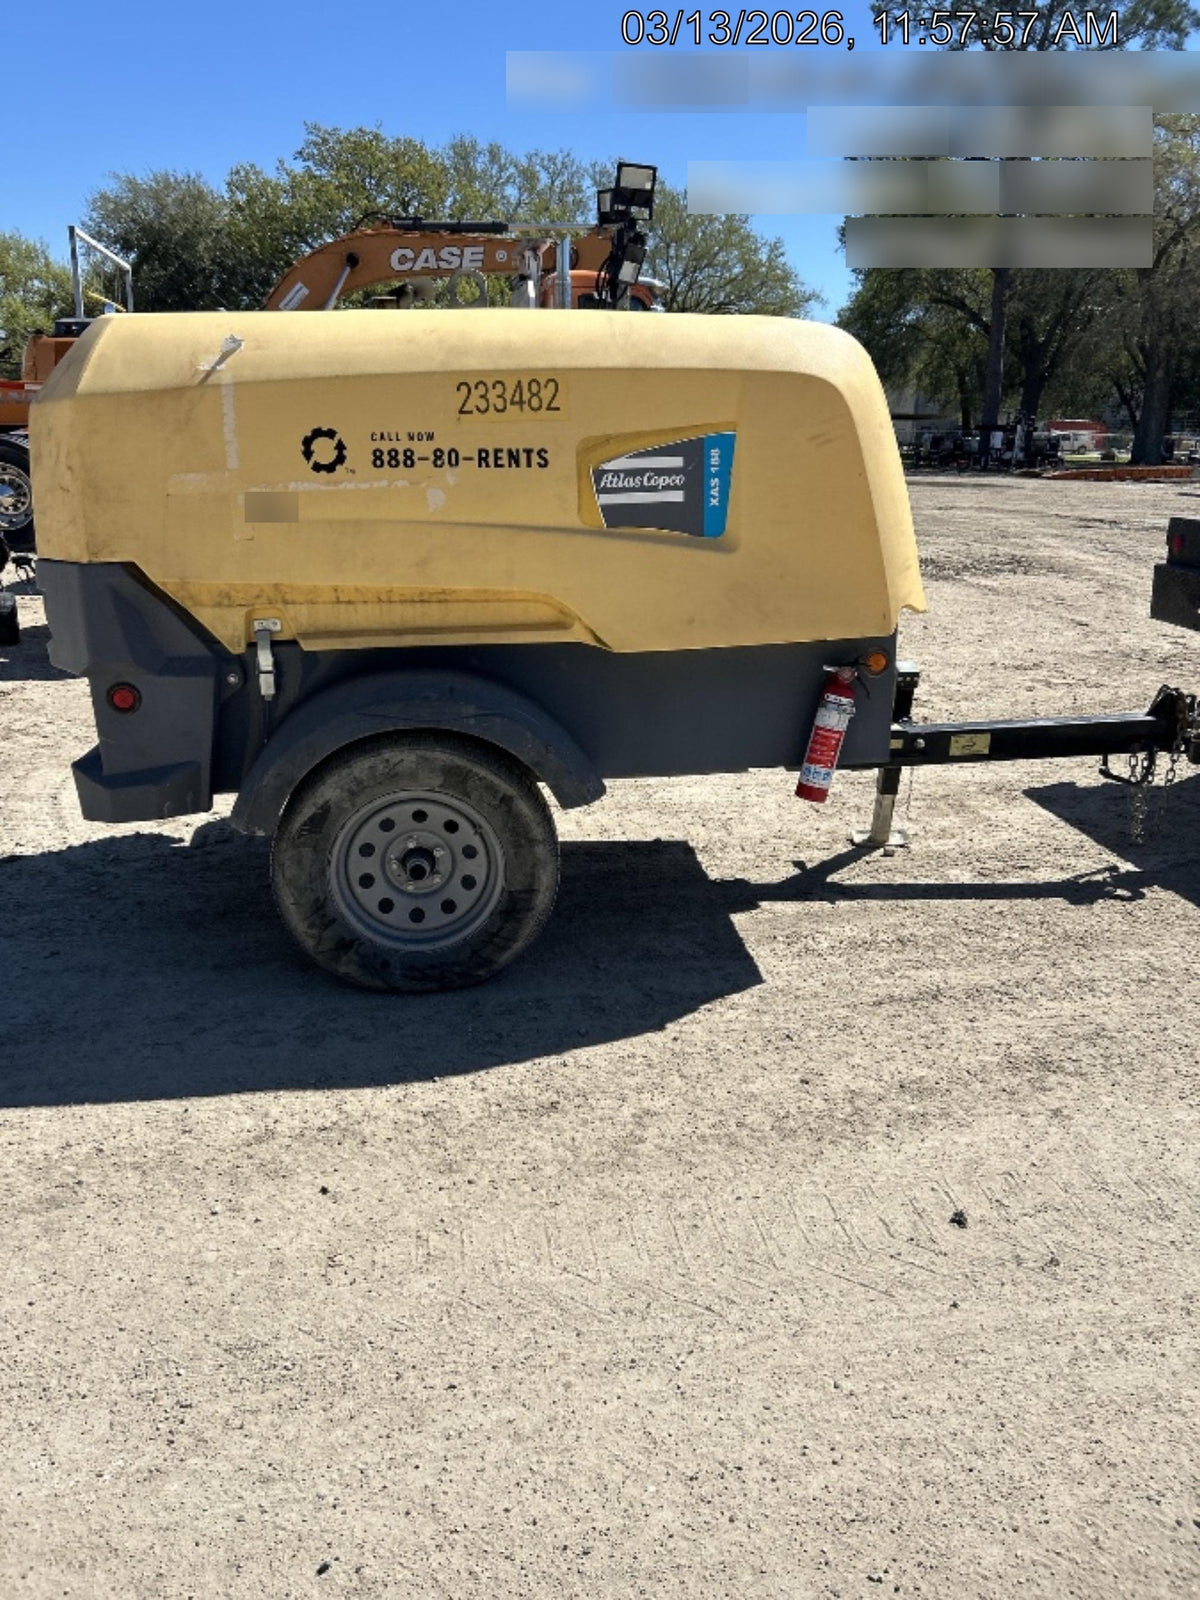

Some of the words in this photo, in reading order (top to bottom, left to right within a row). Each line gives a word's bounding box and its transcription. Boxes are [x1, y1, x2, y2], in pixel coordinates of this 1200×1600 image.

[390, 246, 485, 271] CASE
[456, 379, 561, 414] 233482
[371, 431, 401, 441] CALL
[408, 431, 435, 441] NOW
[372, 448, 549, 469] 888-80-RENTS
[710, 447, 720, 474] 188
[600, 472, 642, 489] Atlas
[642, 470, 685, 489] Copco
[709, 477, 720, 506] XAS
